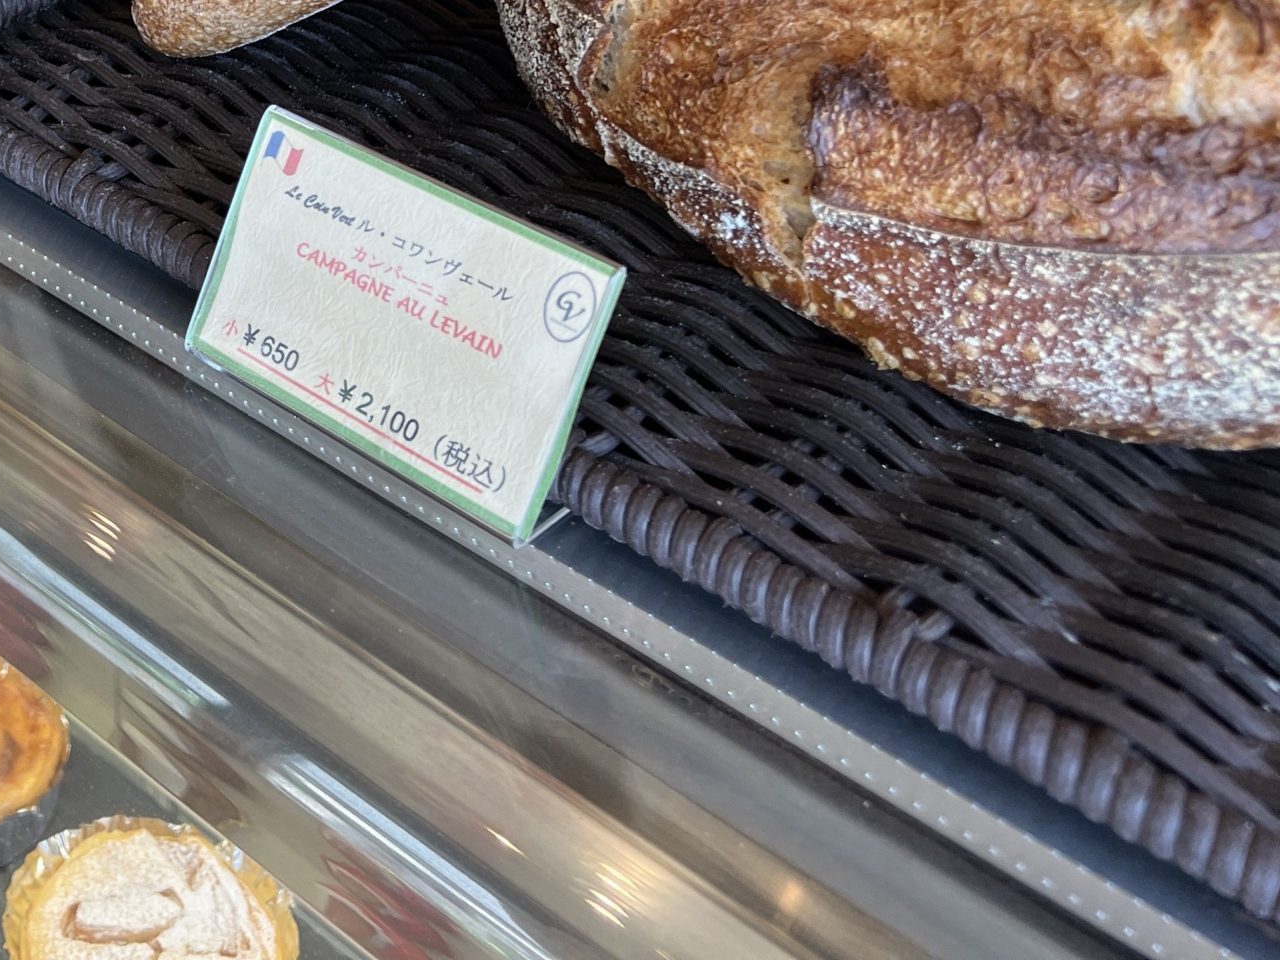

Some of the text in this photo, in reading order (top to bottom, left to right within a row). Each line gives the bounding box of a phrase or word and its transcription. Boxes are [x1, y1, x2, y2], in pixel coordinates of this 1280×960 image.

[284, 185, 303, 201] Le
[356, 219, 513, 301] ル・コワンヴェール
[351, 246, 449, 307] カンパーニュ
[296, 242, 503, 359] CAMPAGNE AU LEVAIN
[221, 319, 239, 337] 小
[313, 372, 335, 396] 大
